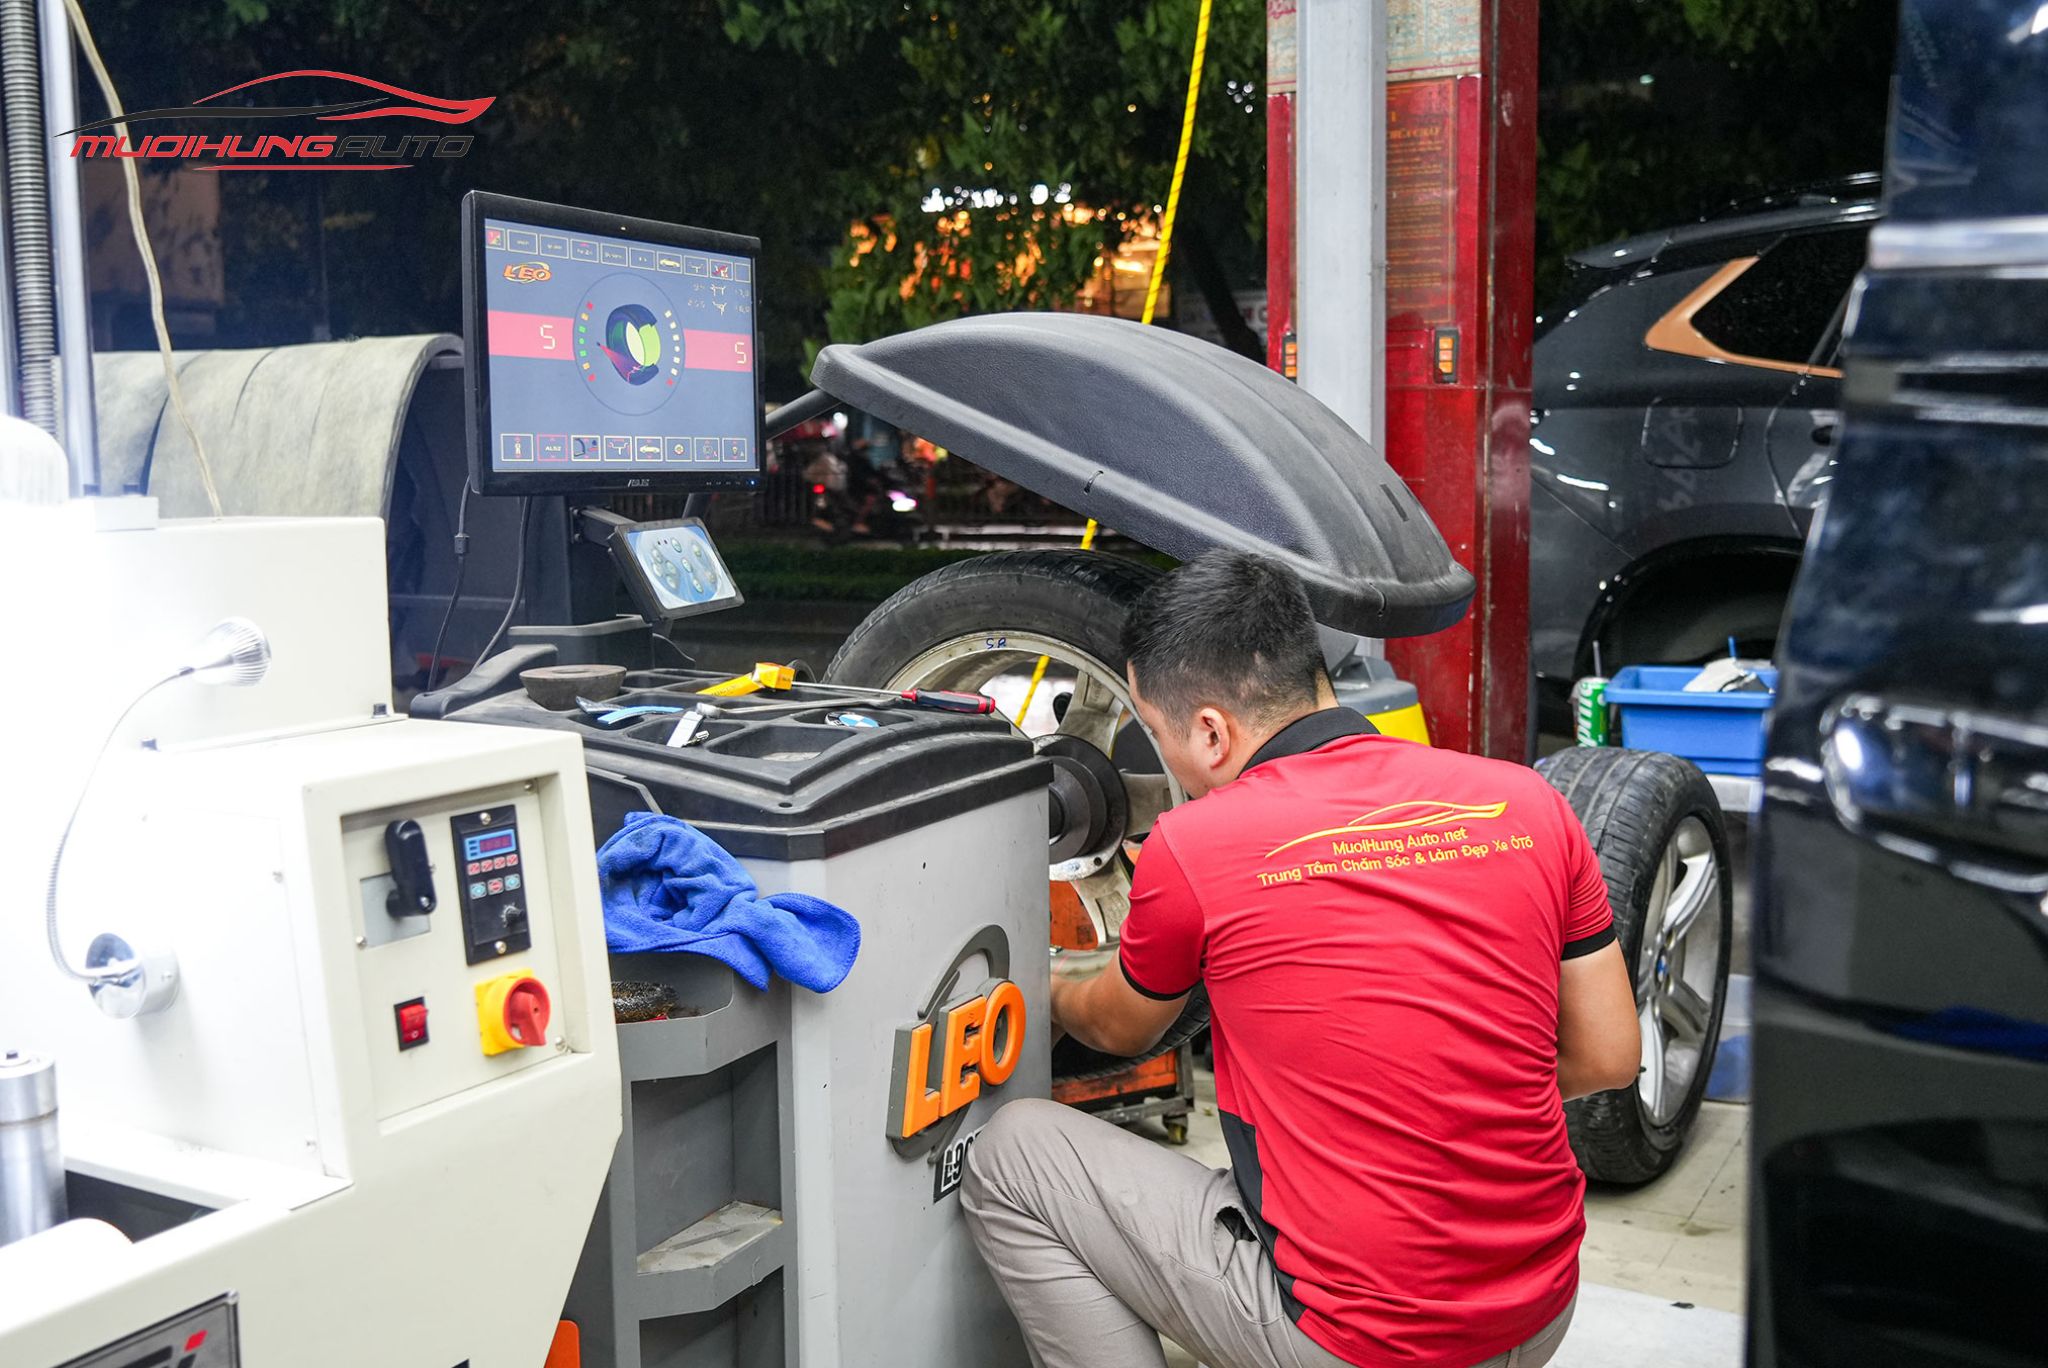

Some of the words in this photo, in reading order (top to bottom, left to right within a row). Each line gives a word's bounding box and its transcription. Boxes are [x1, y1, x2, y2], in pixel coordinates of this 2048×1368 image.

[503, 264, 552, 283] LEO
[1257, 867, 1303, 886] Trung
[1304, 861, 1338, 876] Tâm
[1385, 853, 1411, 869] Sóc
[1414, 851, 1427, 865] &
[1461, 844, 1490, 859] Đẹp
[1492, 839, 1509, 852] Xe
[900, 980, 1027, 1138] LEO
